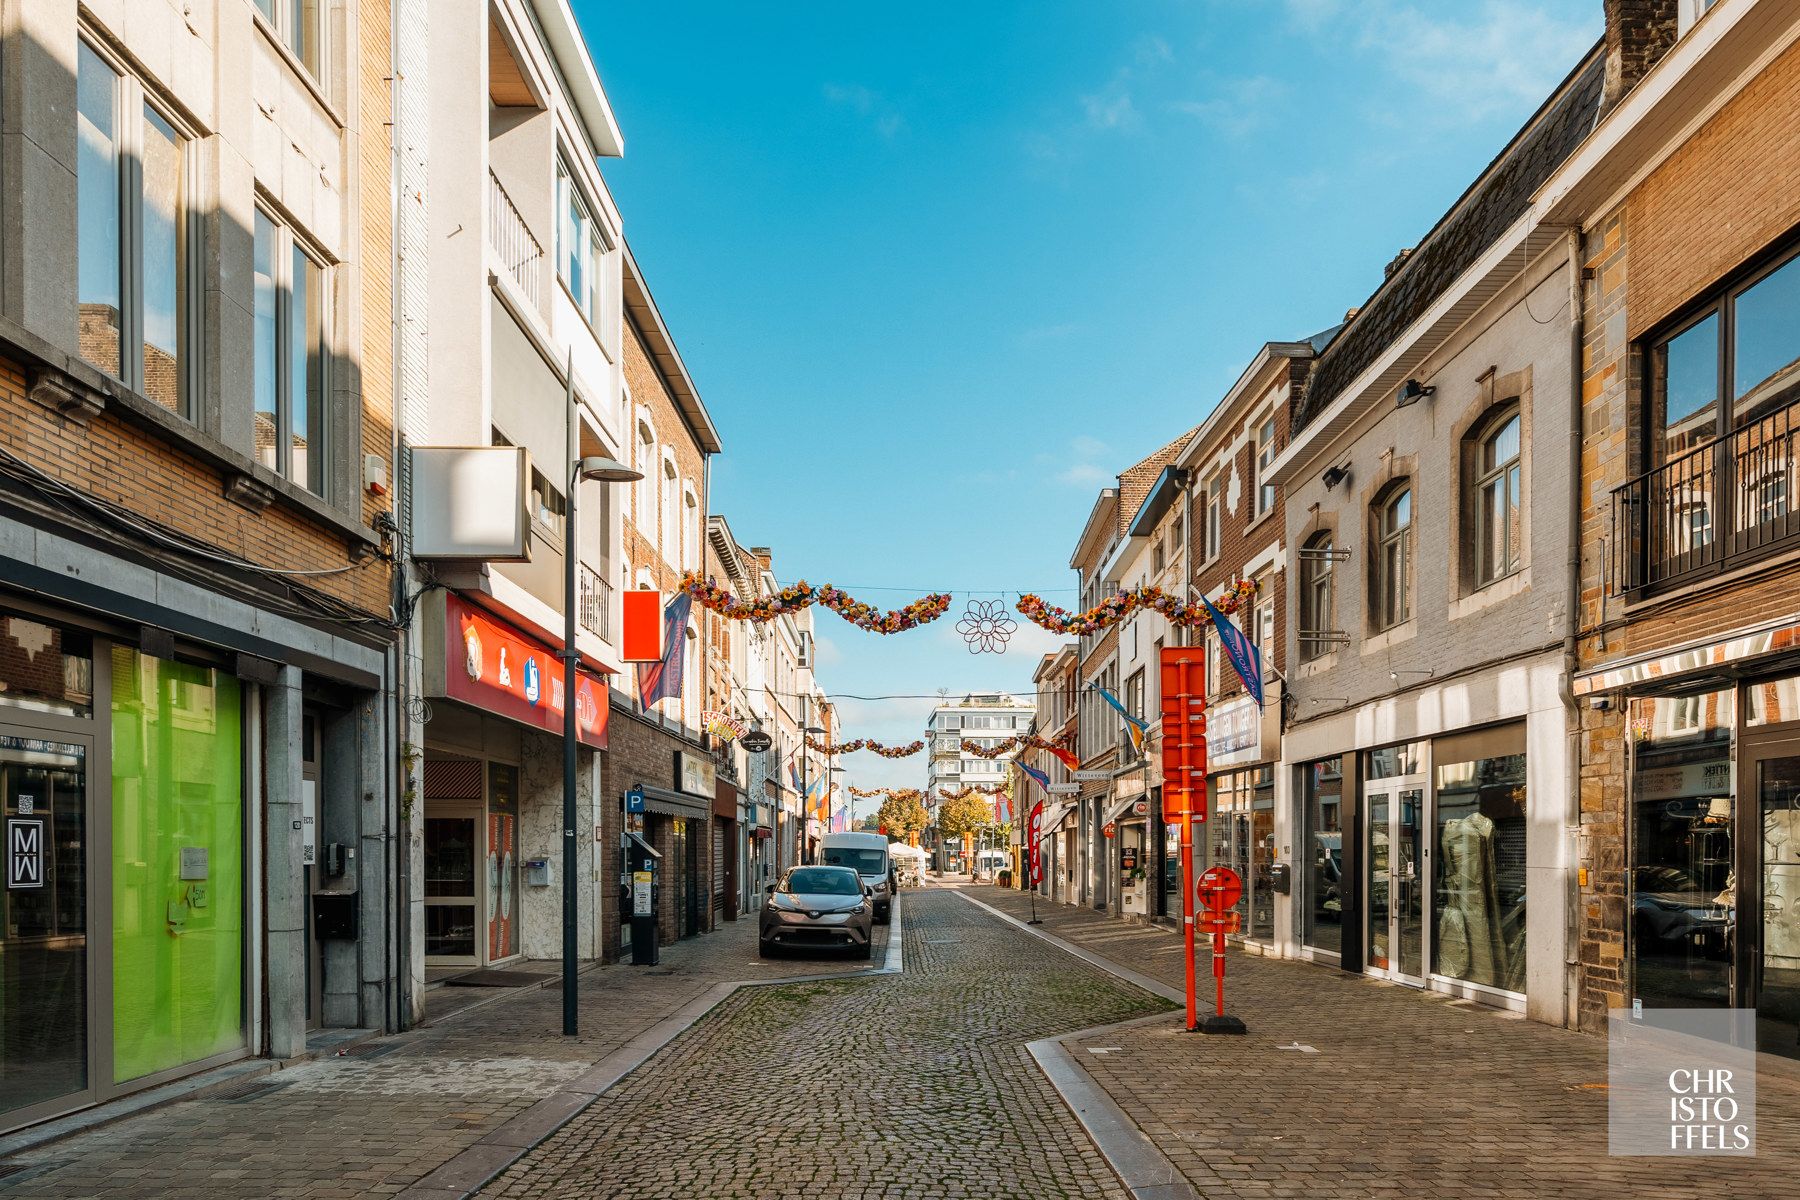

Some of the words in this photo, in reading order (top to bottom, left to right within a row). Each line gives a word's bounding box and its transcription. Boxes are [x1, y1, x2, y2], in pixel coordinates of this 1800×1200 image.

[706, 712, 747, 739] SCHOENEN
[631, 796, 641, 808] P
[644, 860, 653, 870] P
